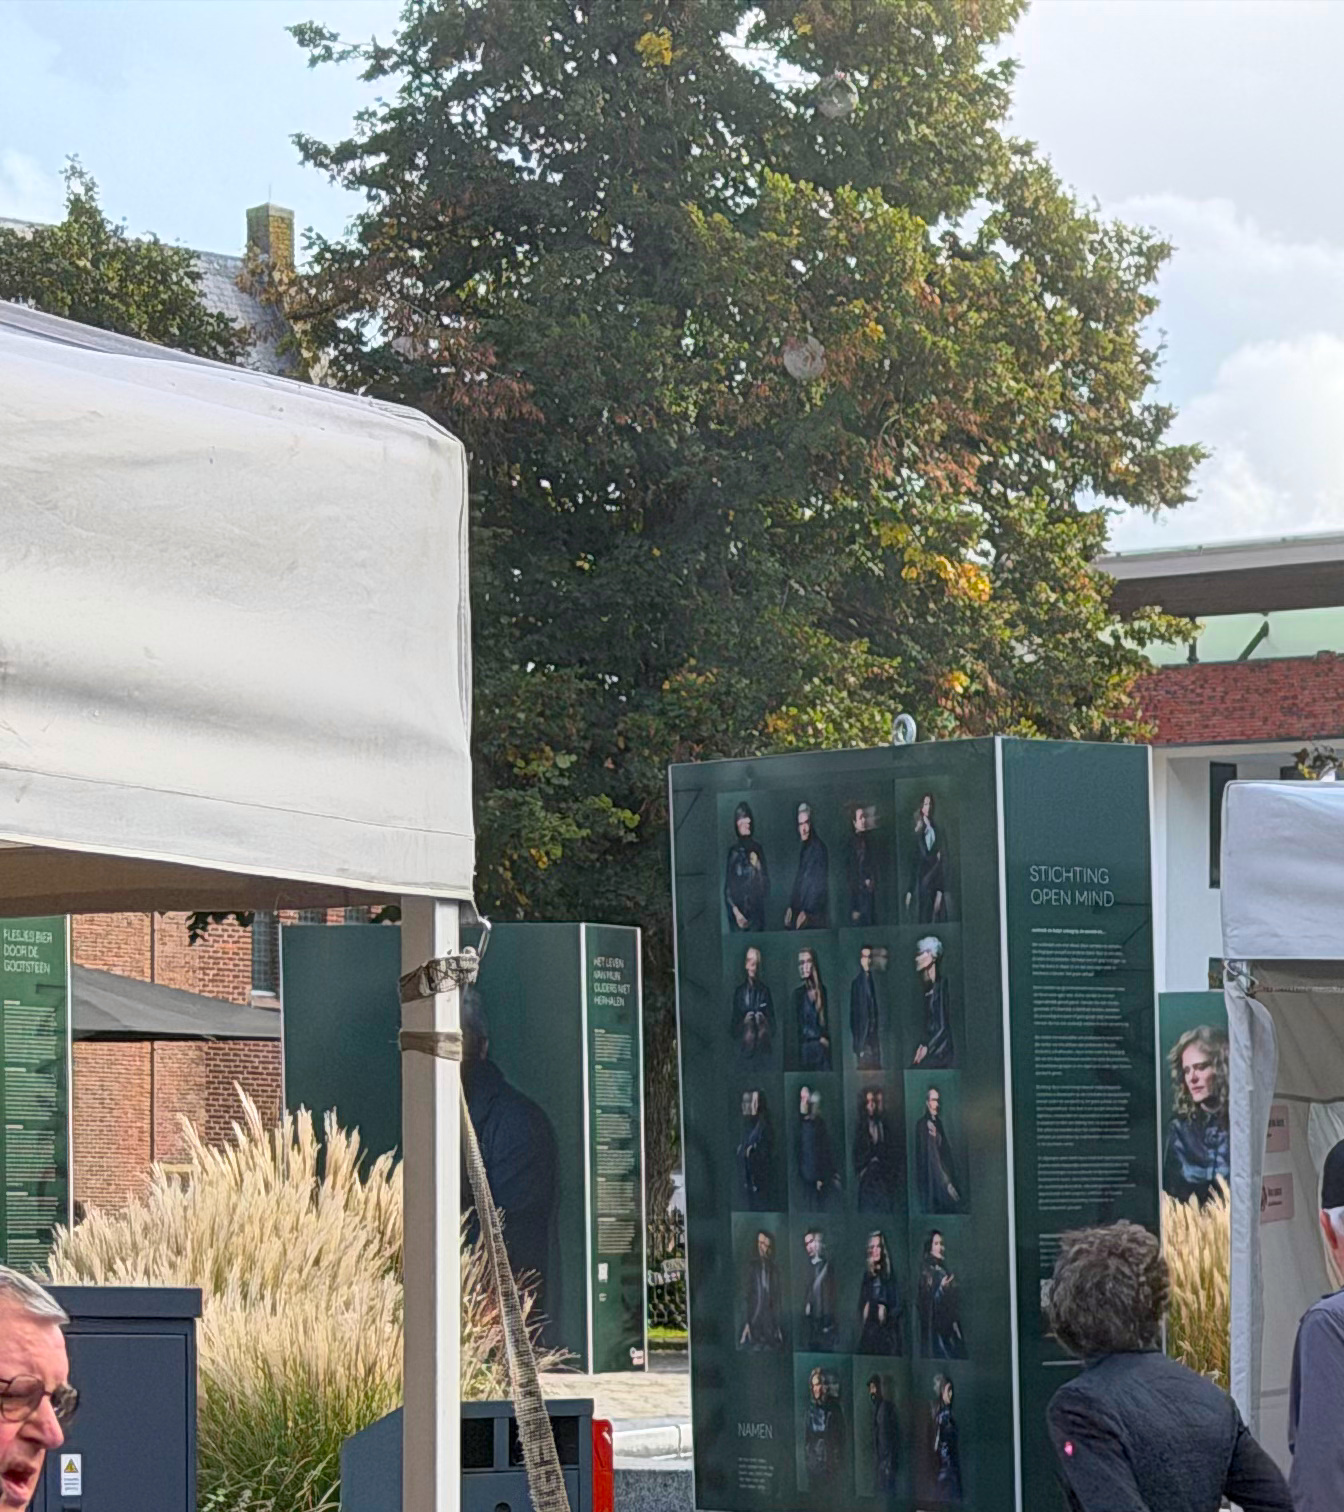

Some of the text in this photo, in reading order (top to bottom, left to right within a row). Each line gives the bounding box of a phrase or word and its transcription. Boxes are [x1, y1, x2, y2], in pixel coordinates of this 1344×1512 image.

[1029, 865, 1110, 885] STICHTING
[1030, 888, 1115, 907] OPEN MIND
[3, 943, 39, 958] DOOR DE
[737, 1422, 774, 1439] NAMEN
